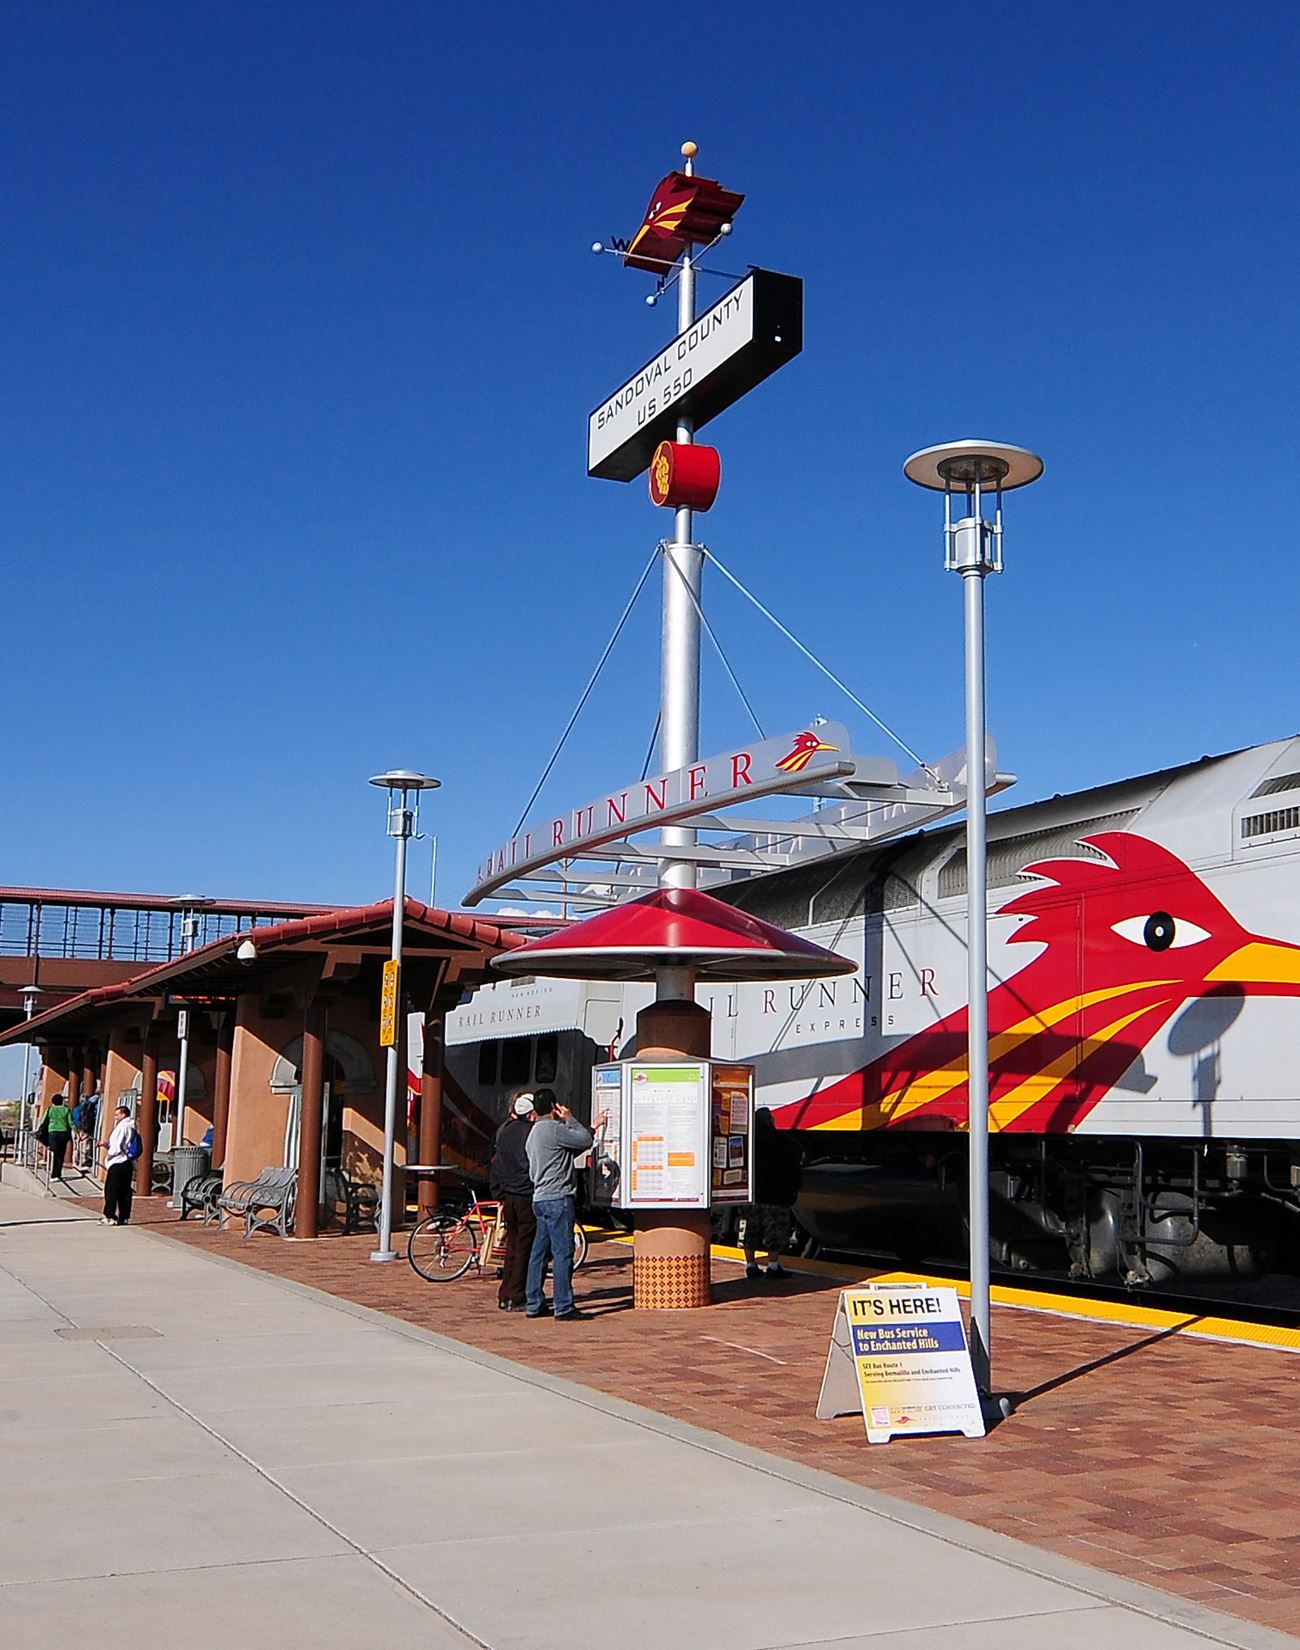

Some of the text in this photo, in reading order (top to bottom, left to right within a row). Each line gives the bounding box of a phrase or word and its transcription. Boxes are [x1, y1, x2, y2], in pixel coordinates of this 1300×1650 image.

[598, 289, 743, 430] SANDOVAL COUNTY
[637, 367, 693, 426] US 550
[552, 752, 753, 848] RUNNER
[763, 968, 938, 1014] RUNNER
[458, 1005, 541, 1028] RAIL RUNNER
[796, 1015, 894, 1034] EXPRESS
[852, 1298, 942, 1316] IT'S HERE!
[857, 1327, 929, 1340] New Bus Service
[859, 1337, 939, 1352] to Enchanted Hills
